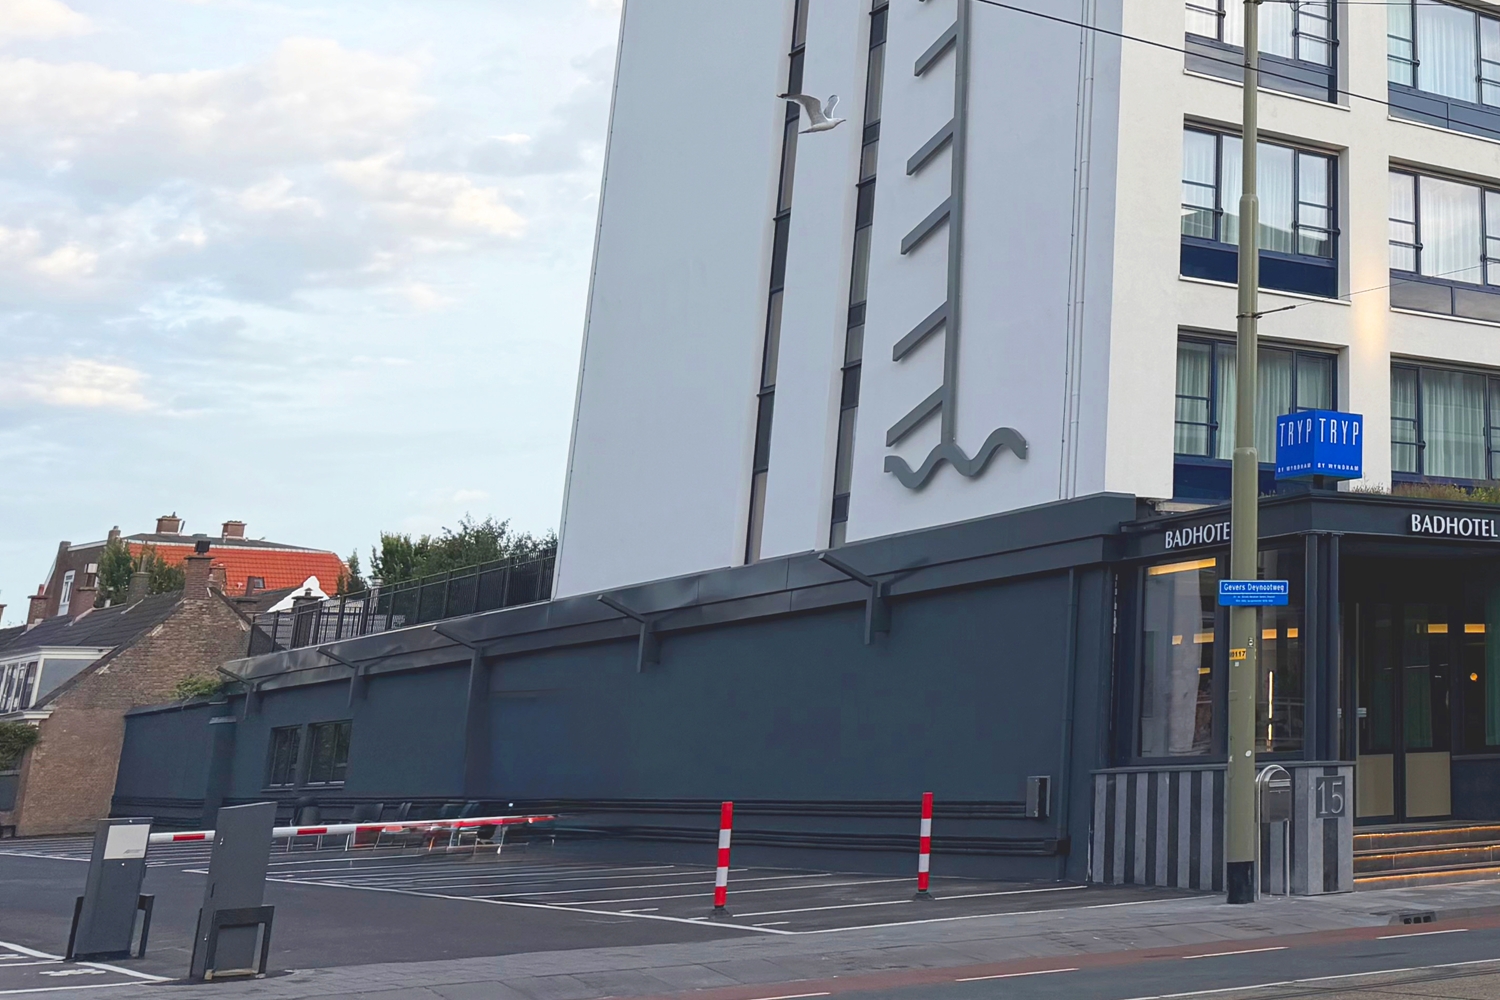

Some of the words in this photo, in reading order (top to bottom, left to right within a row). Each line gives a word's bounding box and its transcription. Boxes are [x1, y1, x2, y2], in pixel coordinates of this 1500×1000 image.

[1279, 418, 1312, 447] TRYP
[1319, 417, 1360, 446] TRYP
[1328, 463, 1359, 471] WYNDHAM
[1165, 521, 1230, 549] BADHOTE
[1411, 513, 1499, 537] BADHOTEL
[1223, 583, 1246, 591] Gevers
[1317, 780, 1344, 814] 15
